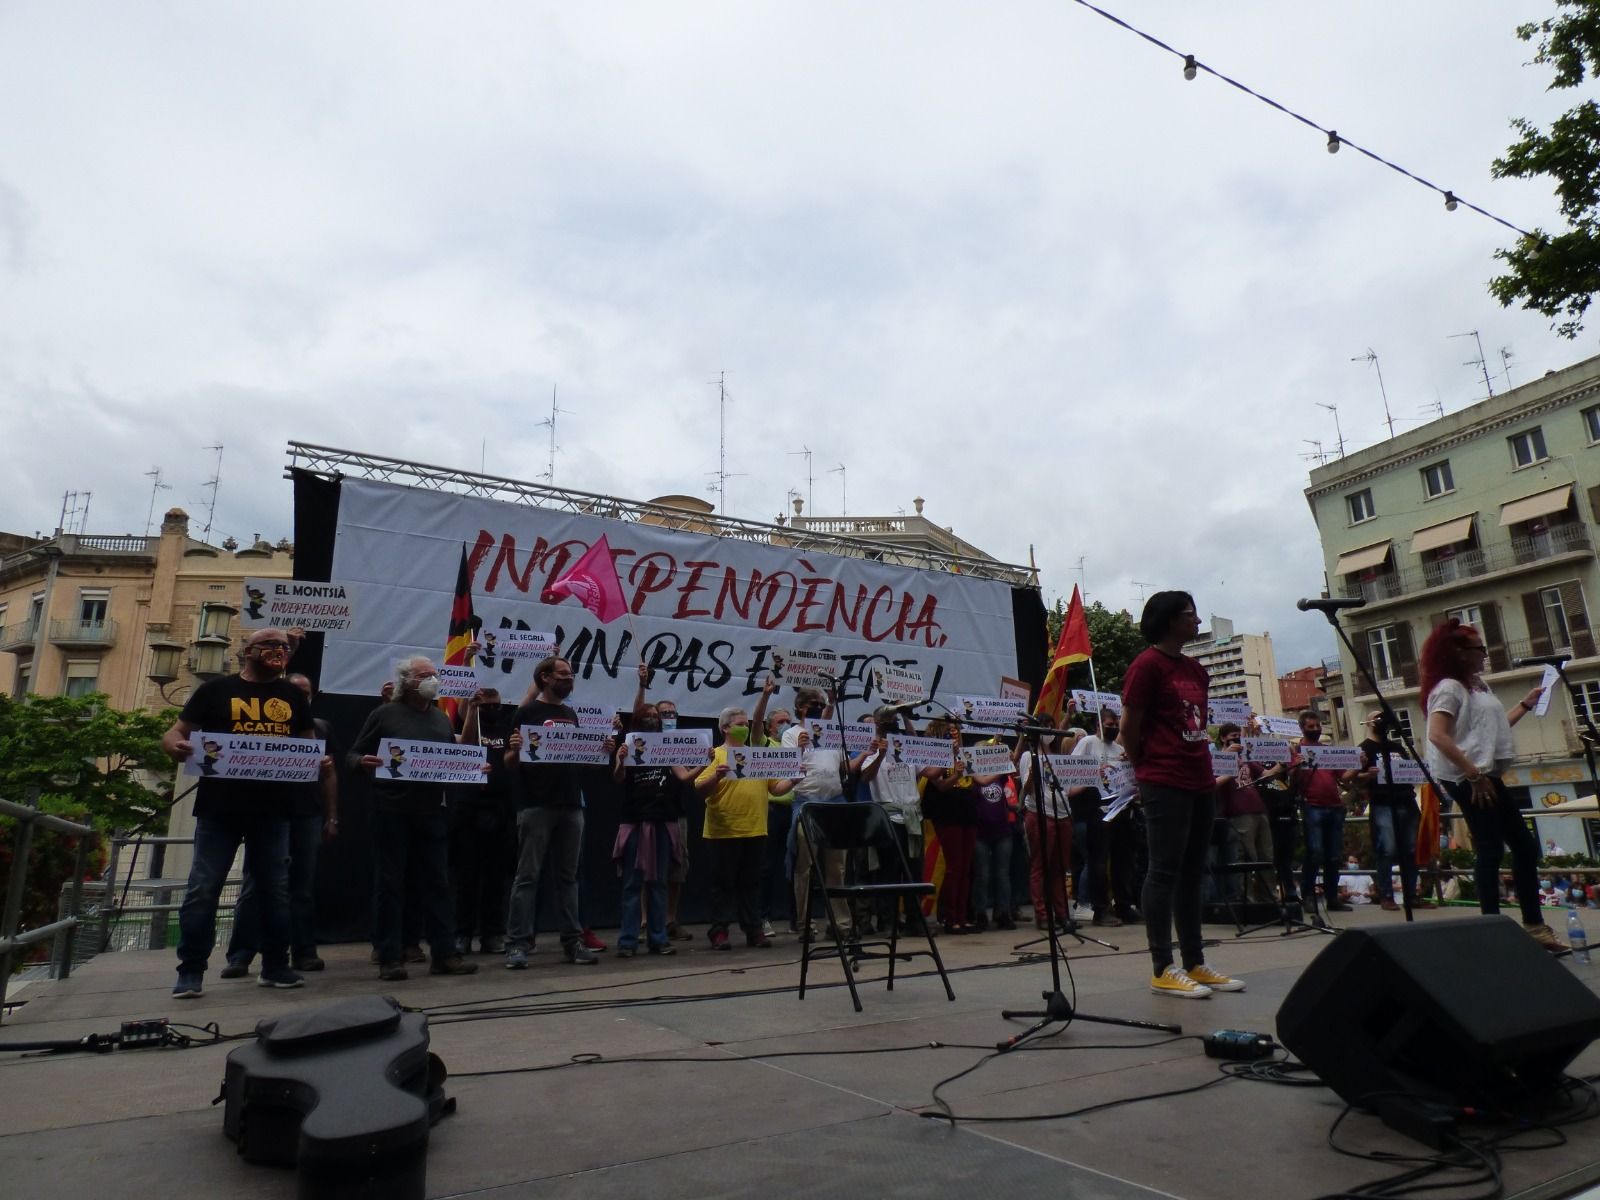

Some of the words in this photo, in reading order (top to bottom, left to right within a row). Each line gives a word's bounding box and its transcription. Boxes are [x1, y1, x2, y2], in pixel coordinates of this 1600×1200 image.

[275, 584, 290, 595] EL
[292, 585, 346, 599] MONTSIÀ
[789, 649, 797, 657] LA
[640, 632, 734, 692] PAS
[231, 697, 293, 723] NO
[232, 721, 290, 734] ACATEM
[229, 740, 261, 750] L'ALT
[264, 742, 321, 754] EMPORDÀ
[673, 737, 697, 745] BAGES
[410, 745, 420, 753] EL
[422, 746, 442, 754] BAIX
[444, 748, 484, 758] EMPORDÀ
